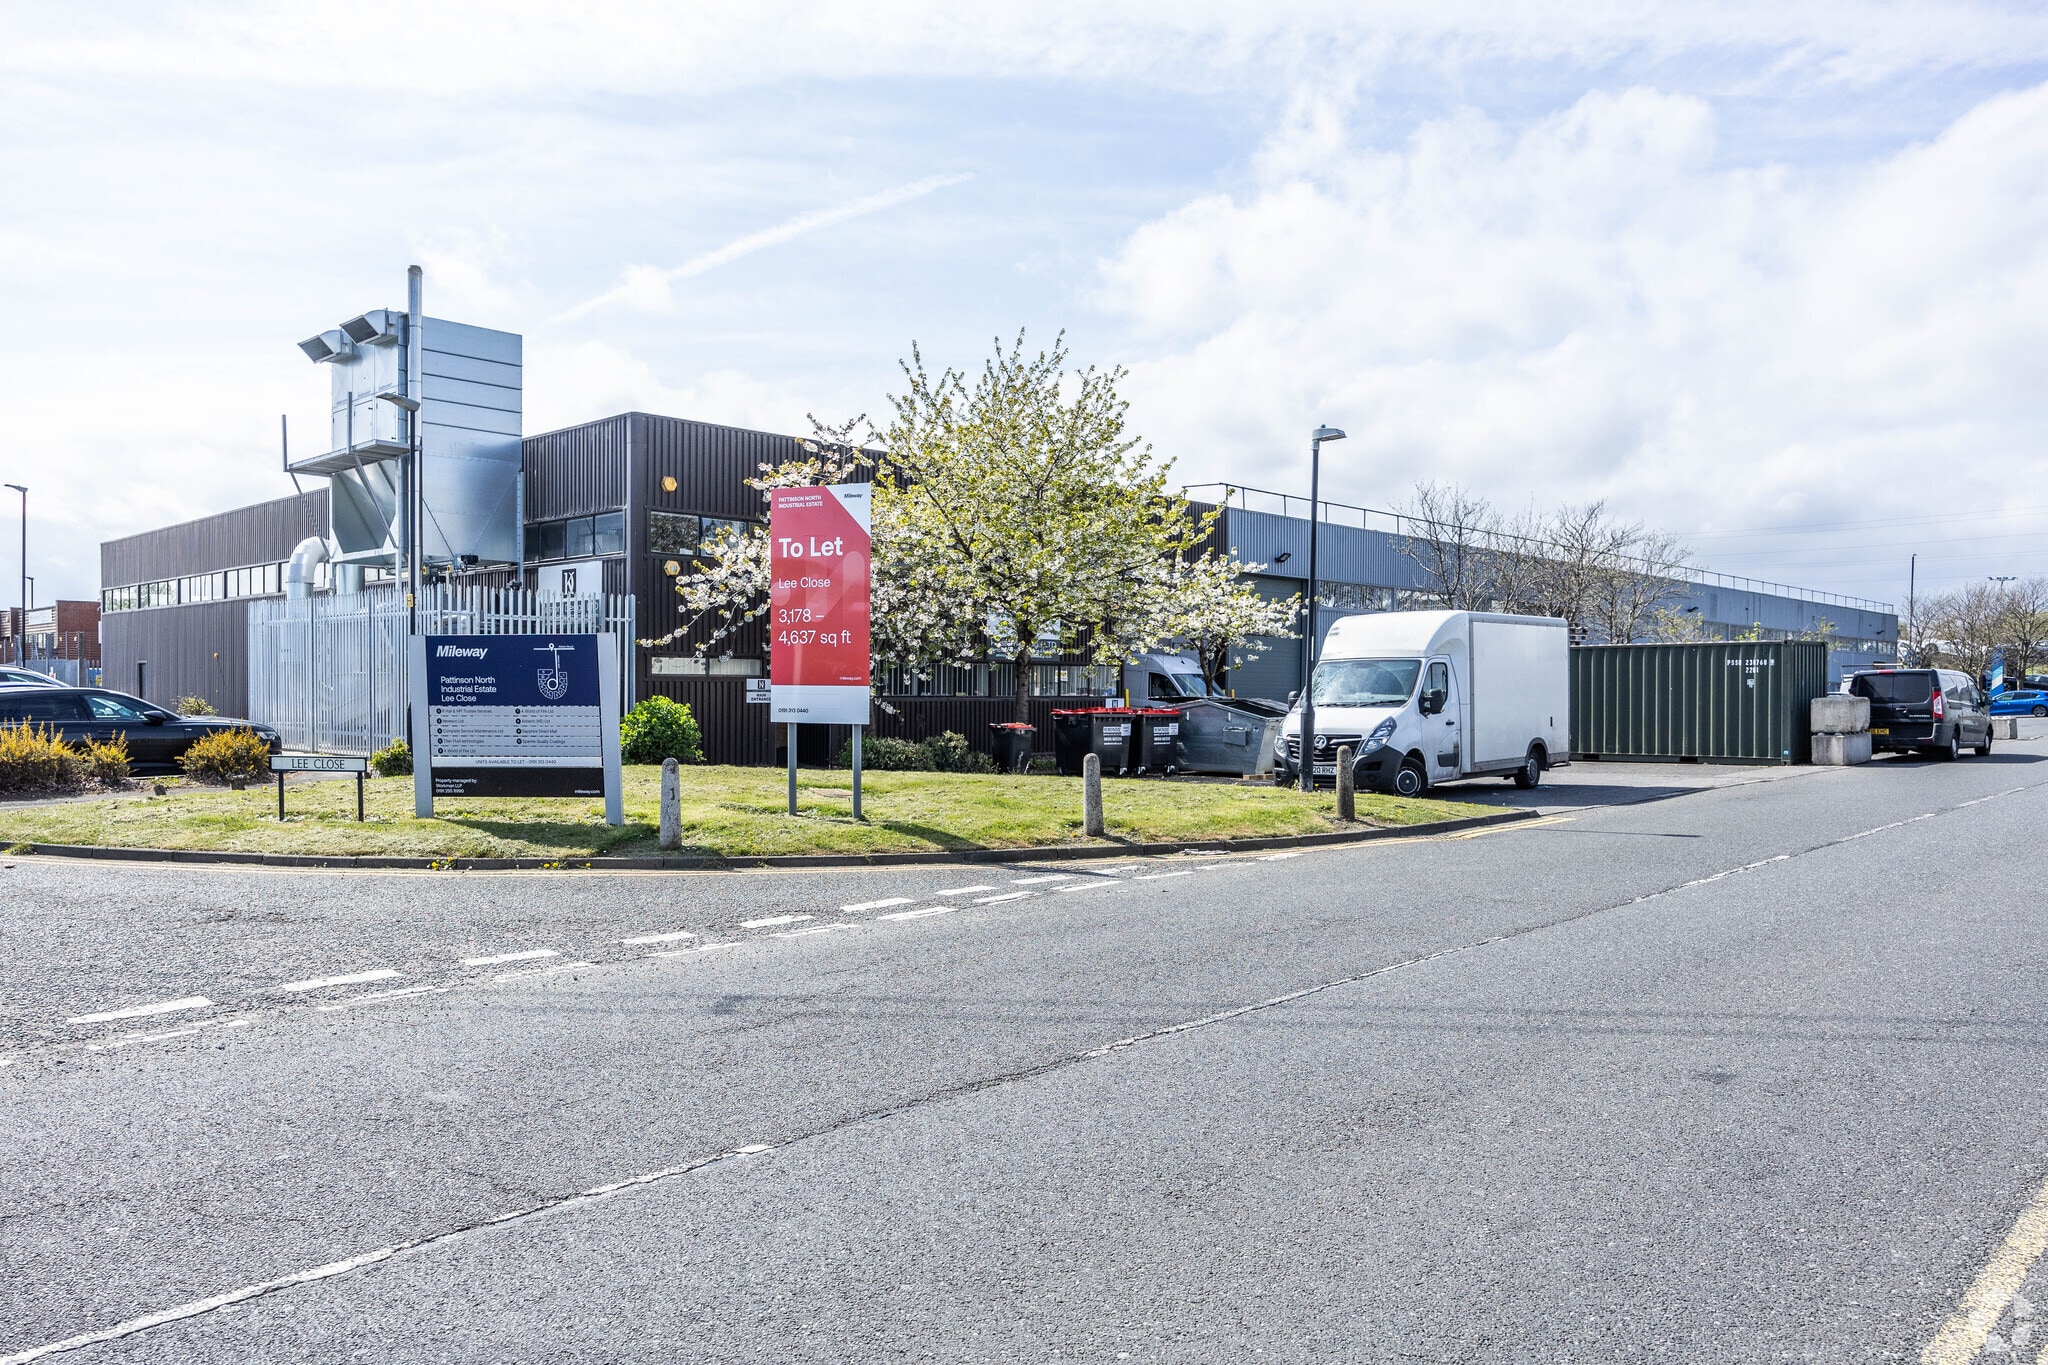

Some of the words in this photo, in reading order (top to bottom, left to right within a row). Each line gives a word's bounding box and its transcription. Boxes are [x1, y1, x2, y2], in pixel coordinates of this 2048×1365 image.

[778, 537, 804, 558] To
[810, 536, 844, 557] Let
[778, 577, 798, 589] Lee
[800, 576, 831, 588] Close
[778, 608, 811, 625] 3,178
[778, 629, 817, 647] 4,637
[820, 632, 837, 648] sq
[841, 629, 852, 644] ft
[436, 645, 489, 660] Mileway
[440, 676, 474, 684] Pattinson
[474, 676, 496, 684] North
[441, 685, 473, 693] Industrial
[474, 685, 497, 693] Estate
[441, 694, 455, 702] Lee
[455, 694, 477, 702] Close
[291, 758, 308, 769] LEE
[313, 758, 345, 769] CLOSE
